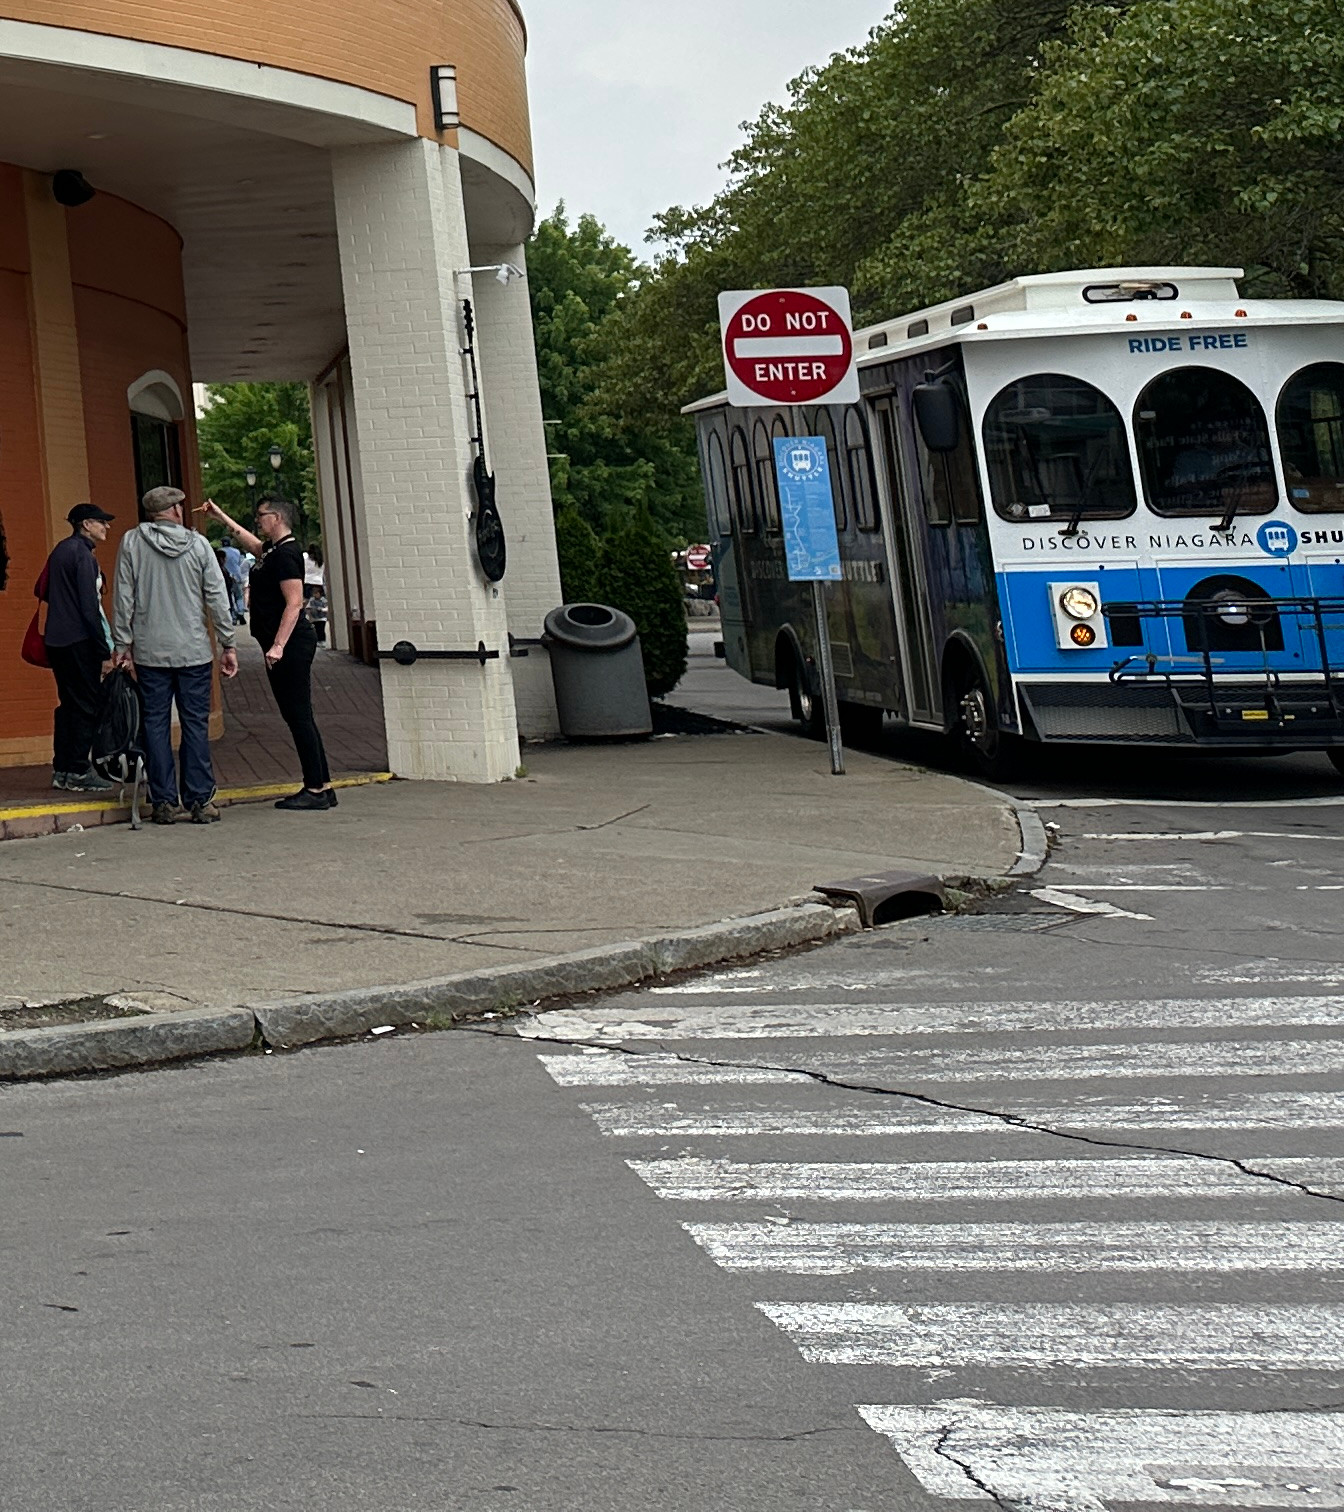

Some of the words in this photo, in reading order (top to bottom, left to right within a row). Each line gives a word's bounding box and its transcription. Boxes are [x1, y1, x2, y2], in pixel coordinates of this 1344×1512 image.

[741, 314, 771, 332] DO
[786, 311, 830, 330] NOT
[1128, 336, 1182, 354] RIDE
[1188, 333, 1248, 352] FREE
[754, 361, 826, 382] ENTER
[1023, 534, 1137, 550] DISCOVER
[1149, 532, 1254, 548] NIAGARA
